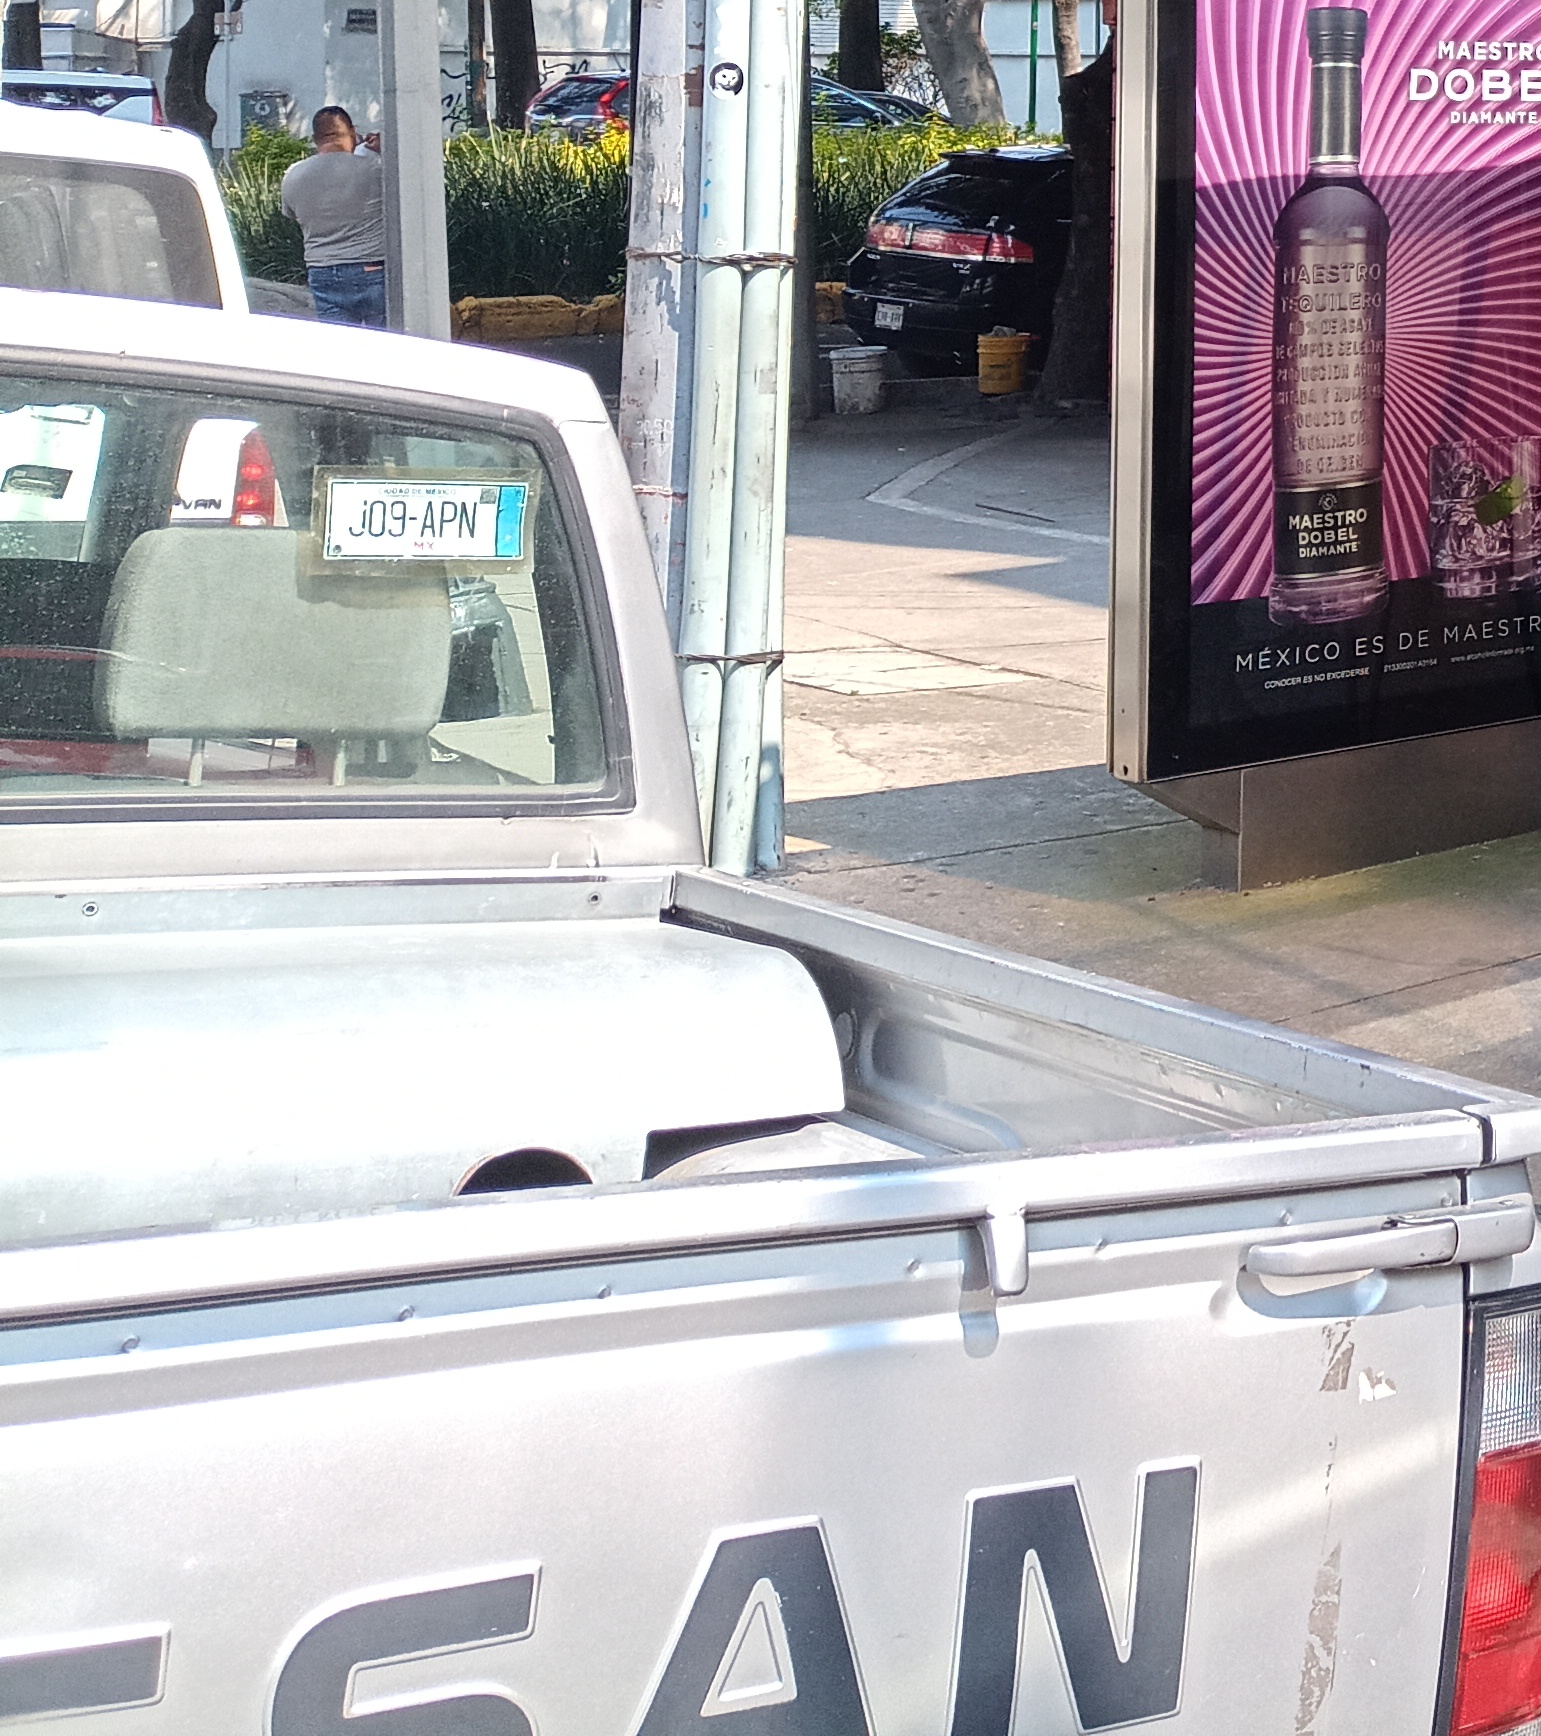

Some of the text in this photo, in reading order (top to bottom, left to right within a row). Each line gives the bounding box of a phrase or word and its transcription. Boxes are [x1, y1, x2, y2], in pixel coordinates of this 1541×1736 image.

[1450, 111, 1538, 124] DIAMANTE
[1283, 262, 1381, 284] MAESTRO
[1281, 292, 1382, 313] TEQUILERO
[1289, 508, 1367, 529] MAESTRO
[1298, 527, 1358, 544] DOBEL
[1299, 542, 1358, 558] DIAMANTE
[1235, 641, 1341, 673] MÉXICO
[1355, 635, 1384, 657] ES
[1399, 630, 1429, 651] DE
[1303, 675, 1312, 684] ES
[1314, 673, 1325, 682] NO
